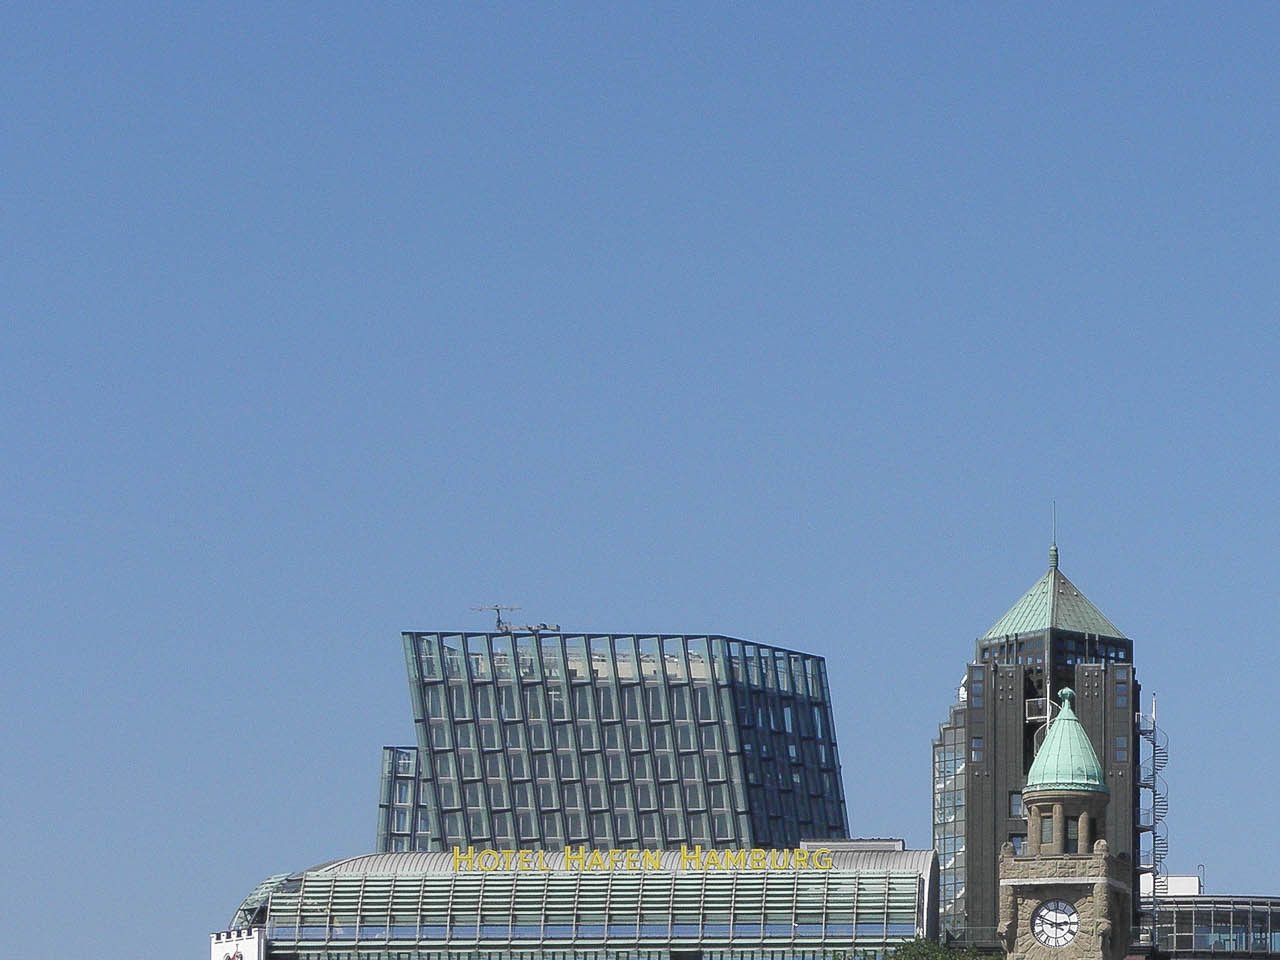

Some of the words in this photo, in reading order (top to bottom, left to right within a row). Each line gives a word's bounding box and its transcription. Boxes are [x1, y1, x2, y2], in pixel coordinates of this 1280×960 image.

[453, 845, 551, 871] HOTEL
[564, 845, 661, 871] HAFEN
[680, 845, 833, 870] HAMBURG
